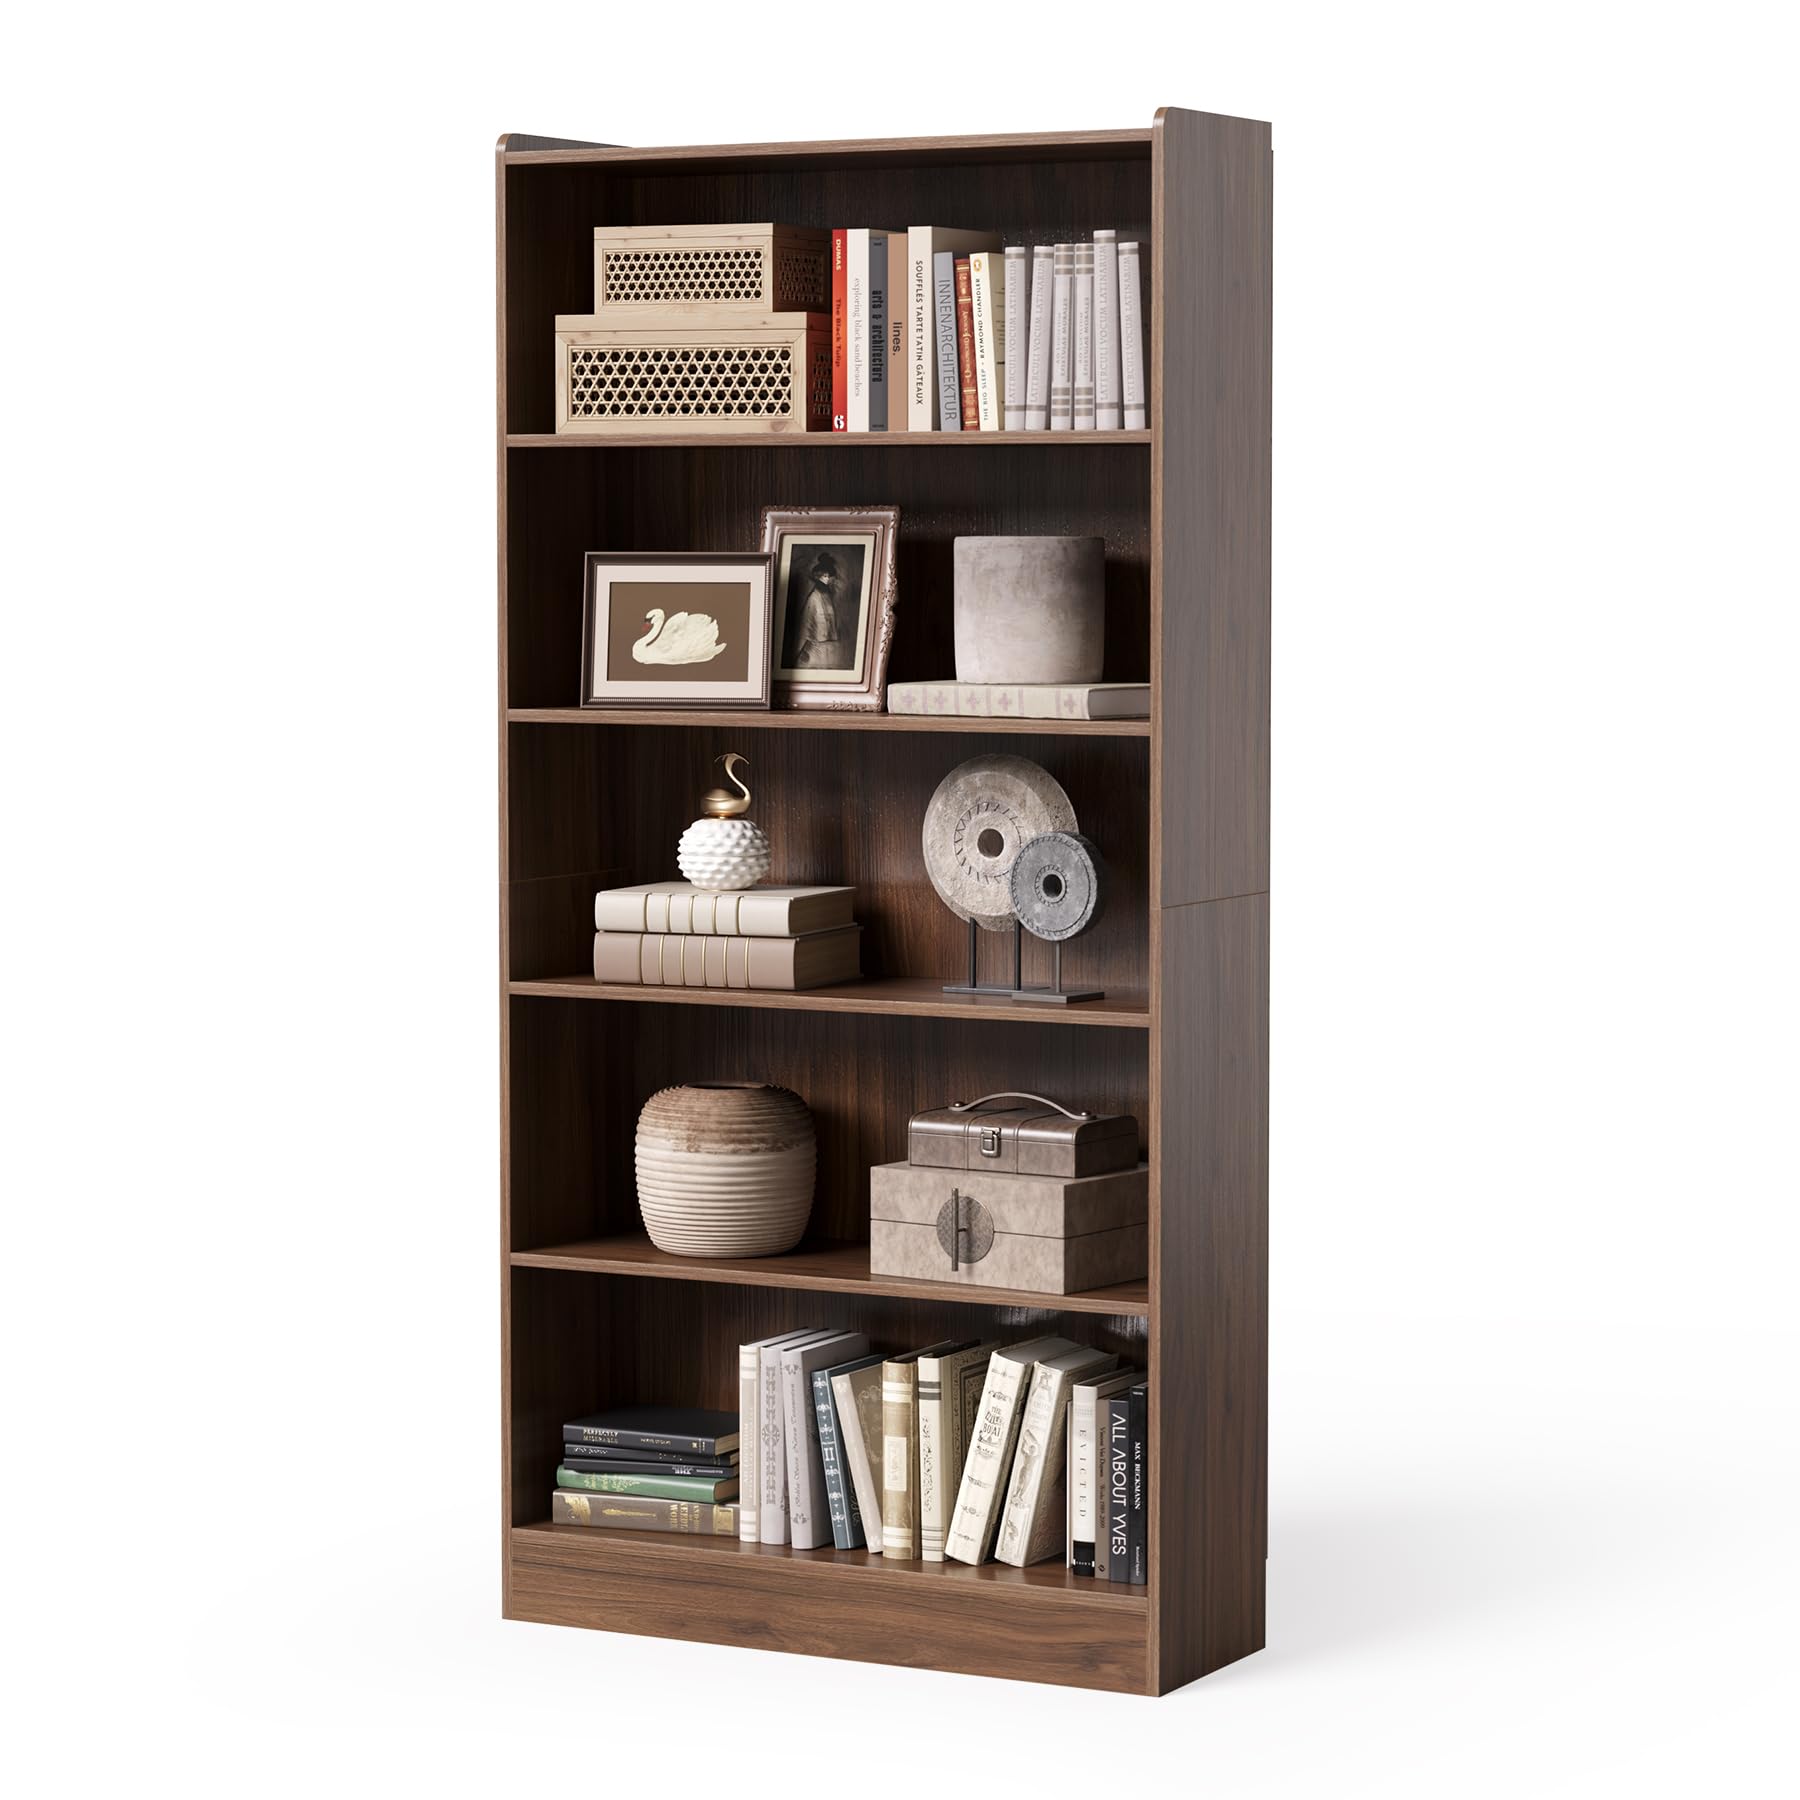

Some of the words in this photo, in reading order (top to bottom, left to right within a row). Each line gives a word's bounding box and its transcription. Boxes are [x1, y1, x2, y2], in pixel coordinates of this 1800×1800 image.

[916, 260, 924, 303] SOUFFLÉS
[1008, 260, 1017, 314] LATINARUM
[1036, 260, 1046, 314] LATINARUM
[1098, 245, 1108, 304] LATINARUM
[1122, 256, 1132, 311] LATINARUM
[852, 278, 862, 317] exploring
[872, 290, 883, 309] arts
[974, 278, 983, 317] CHANDLER
[854, 320, 862, 342] black
[893, 322, 902, 356] lines.
[977, 320, 986, 359] RAYMOND
[1008, 316, 1017, 352] VOCUM
[1032, 316, 1042, 352] VOCUM
[1100, 306, 1108, 345] VOCUM
[1125, 314, 1134, 350] VOCUM
[854, 344, 862, 362] sand
[872, 325, 884, 382] architecture
[938, 280, 958, 420] INNENARCHITEKTUR
[854, 364, 862, 396] beaches
[1112, 1413, 1126, 1443] ALL
[1112, 1448, 1126, 1506] ABOUT
[1112, 1513, 1126, 1555] YVES
